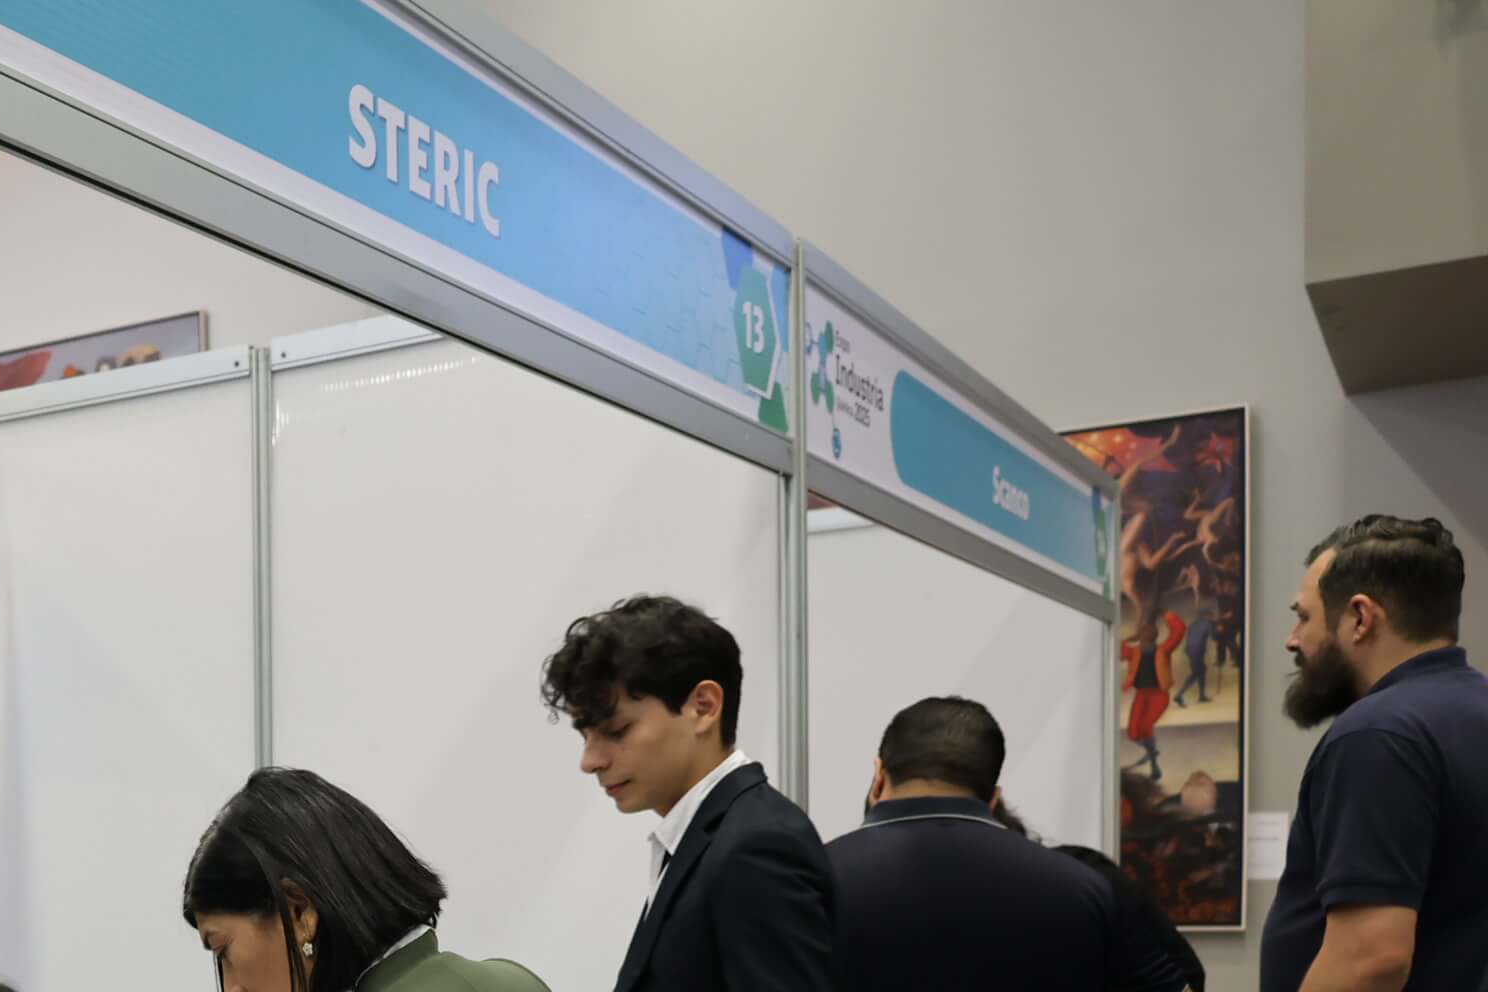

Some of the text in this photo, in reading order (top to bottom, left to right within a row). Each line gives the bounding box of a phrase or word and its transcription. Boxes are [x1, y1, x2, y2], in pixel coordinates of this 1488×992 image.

[349, 84, 501, 239] STERIC
[742, 301, 764, 354] 13
[835, 353, 883, 412] Industria
